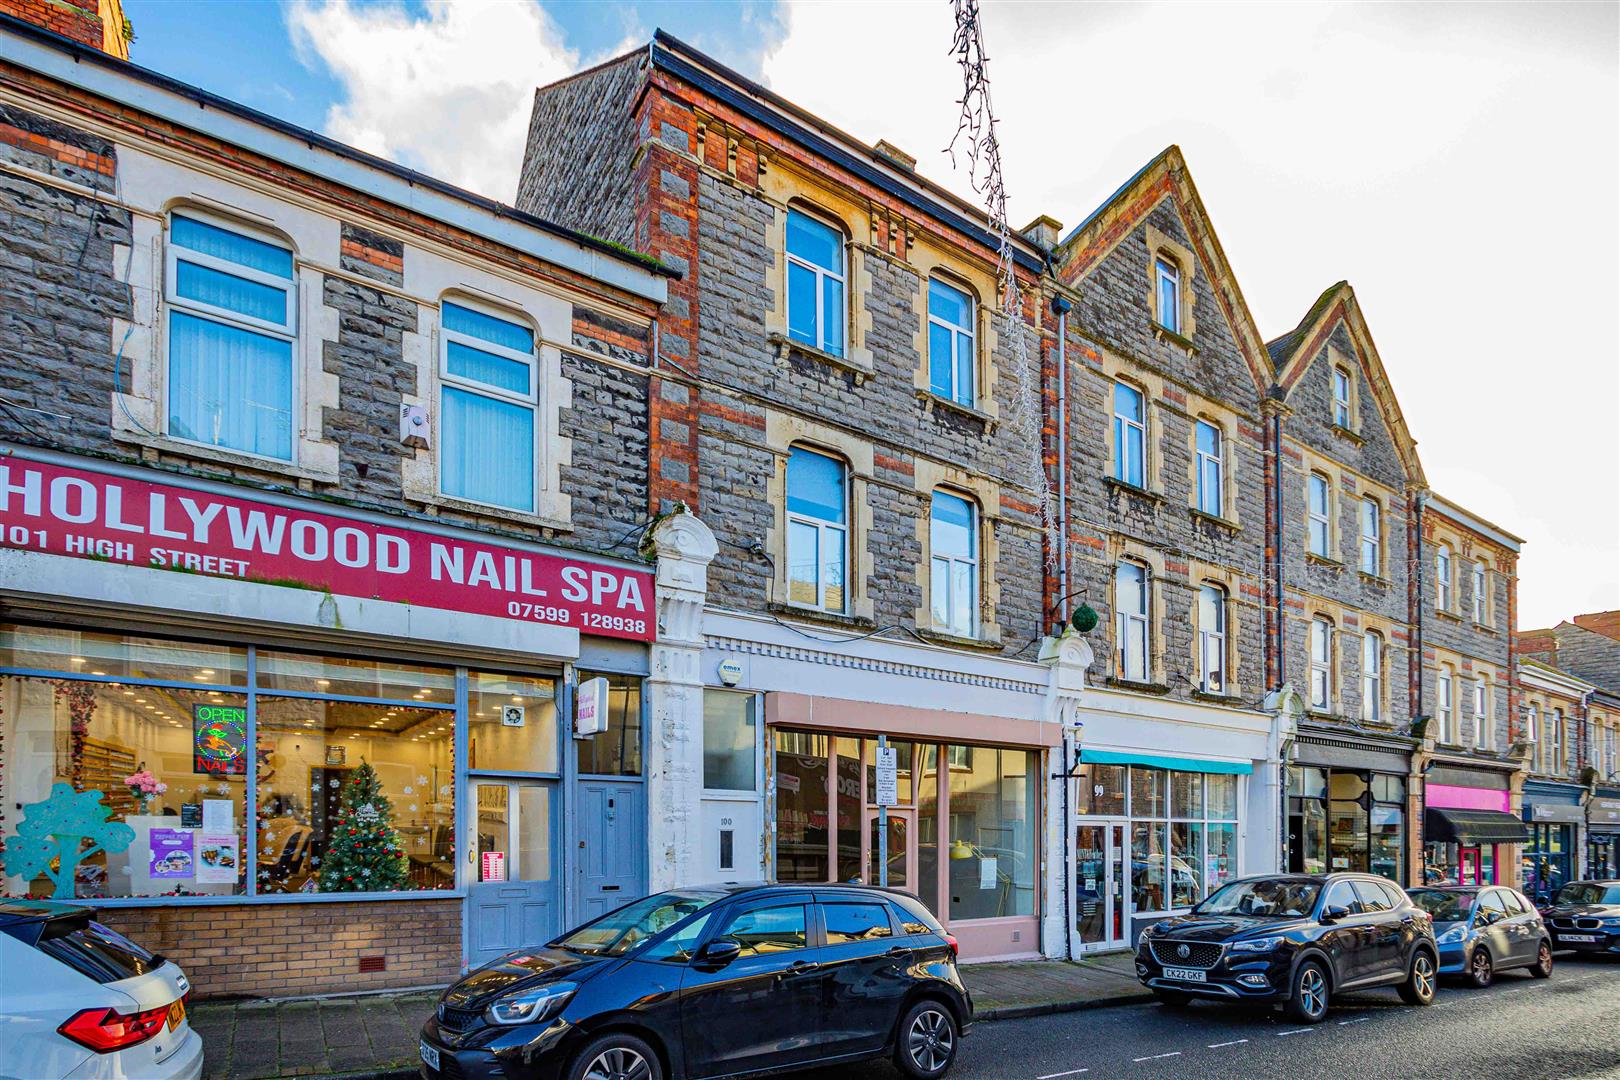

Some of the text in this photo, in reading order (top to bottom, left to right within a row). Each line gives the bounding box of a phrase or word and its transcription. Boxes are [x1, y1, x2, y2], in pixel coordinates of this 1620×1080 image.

[0, 466, 645, 612] HOLLYWOOD NAIL SPA
[66, 534, 134, 561] HIGH
[149, 548, 250, 577] STREET
[508, 601, 646, 634] 07599 128938
[723, 664, 741, 672] emex
[198, 706, 245, 723] OPEN
[1166, 969, 1203, 981] CK22 GKF
